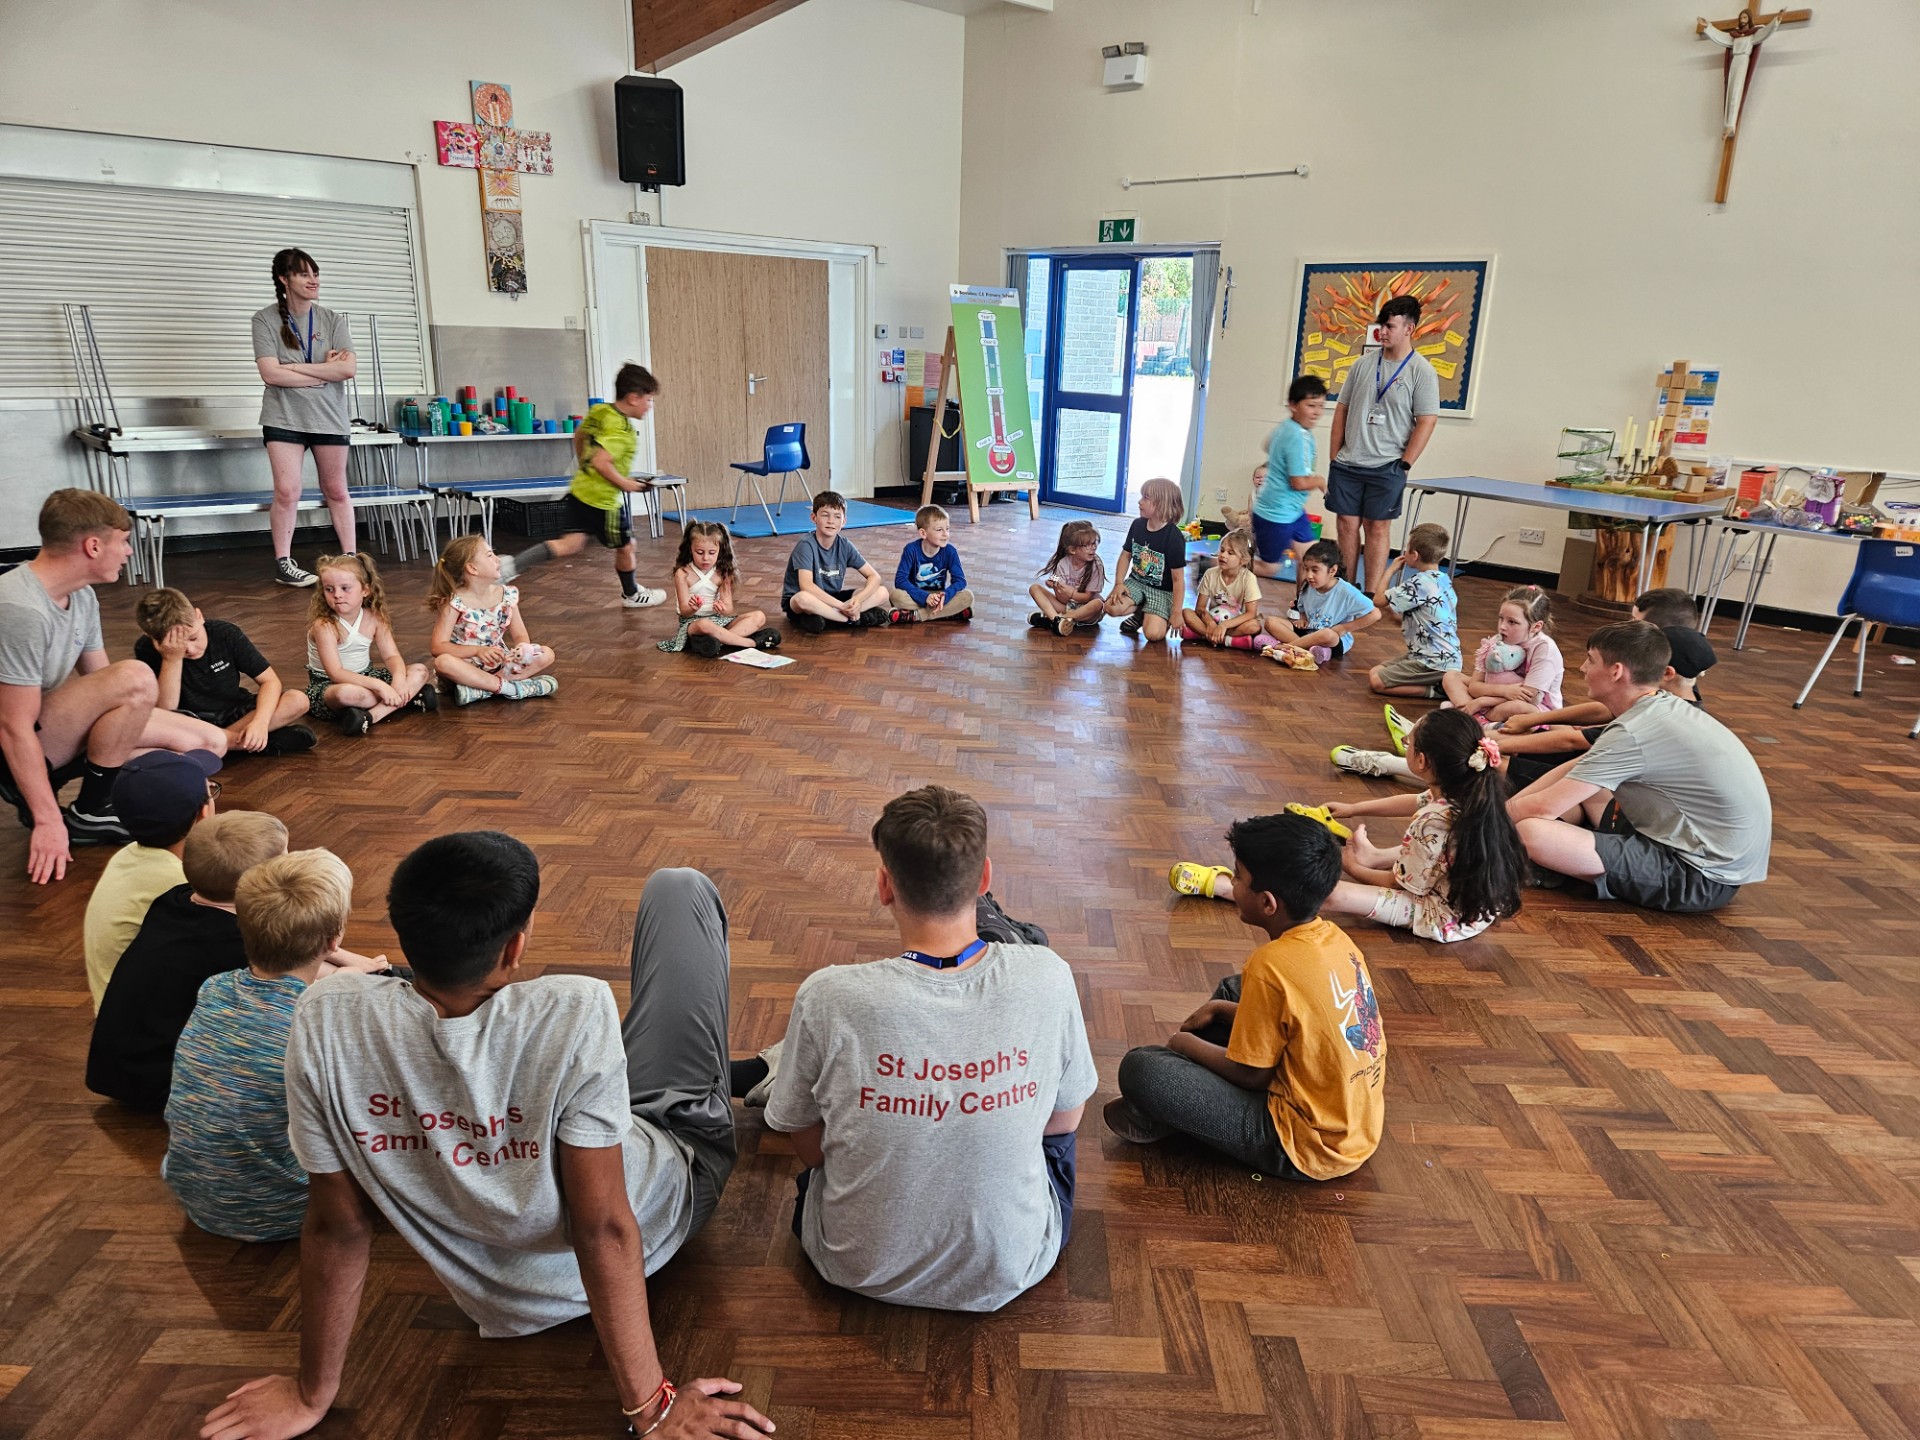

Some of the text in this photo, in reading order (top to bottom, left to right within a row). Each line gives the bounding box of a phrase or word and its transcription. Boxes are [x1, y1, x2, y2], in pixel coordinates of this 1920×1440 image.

[876, 1047, 1028, 1082] St Joseph's
[368, 1093, 523, 1140] St osephs
[859, 1081, 1037, 1122] Family Centre
[352, 1131, 540, 1167] Fami Centre
